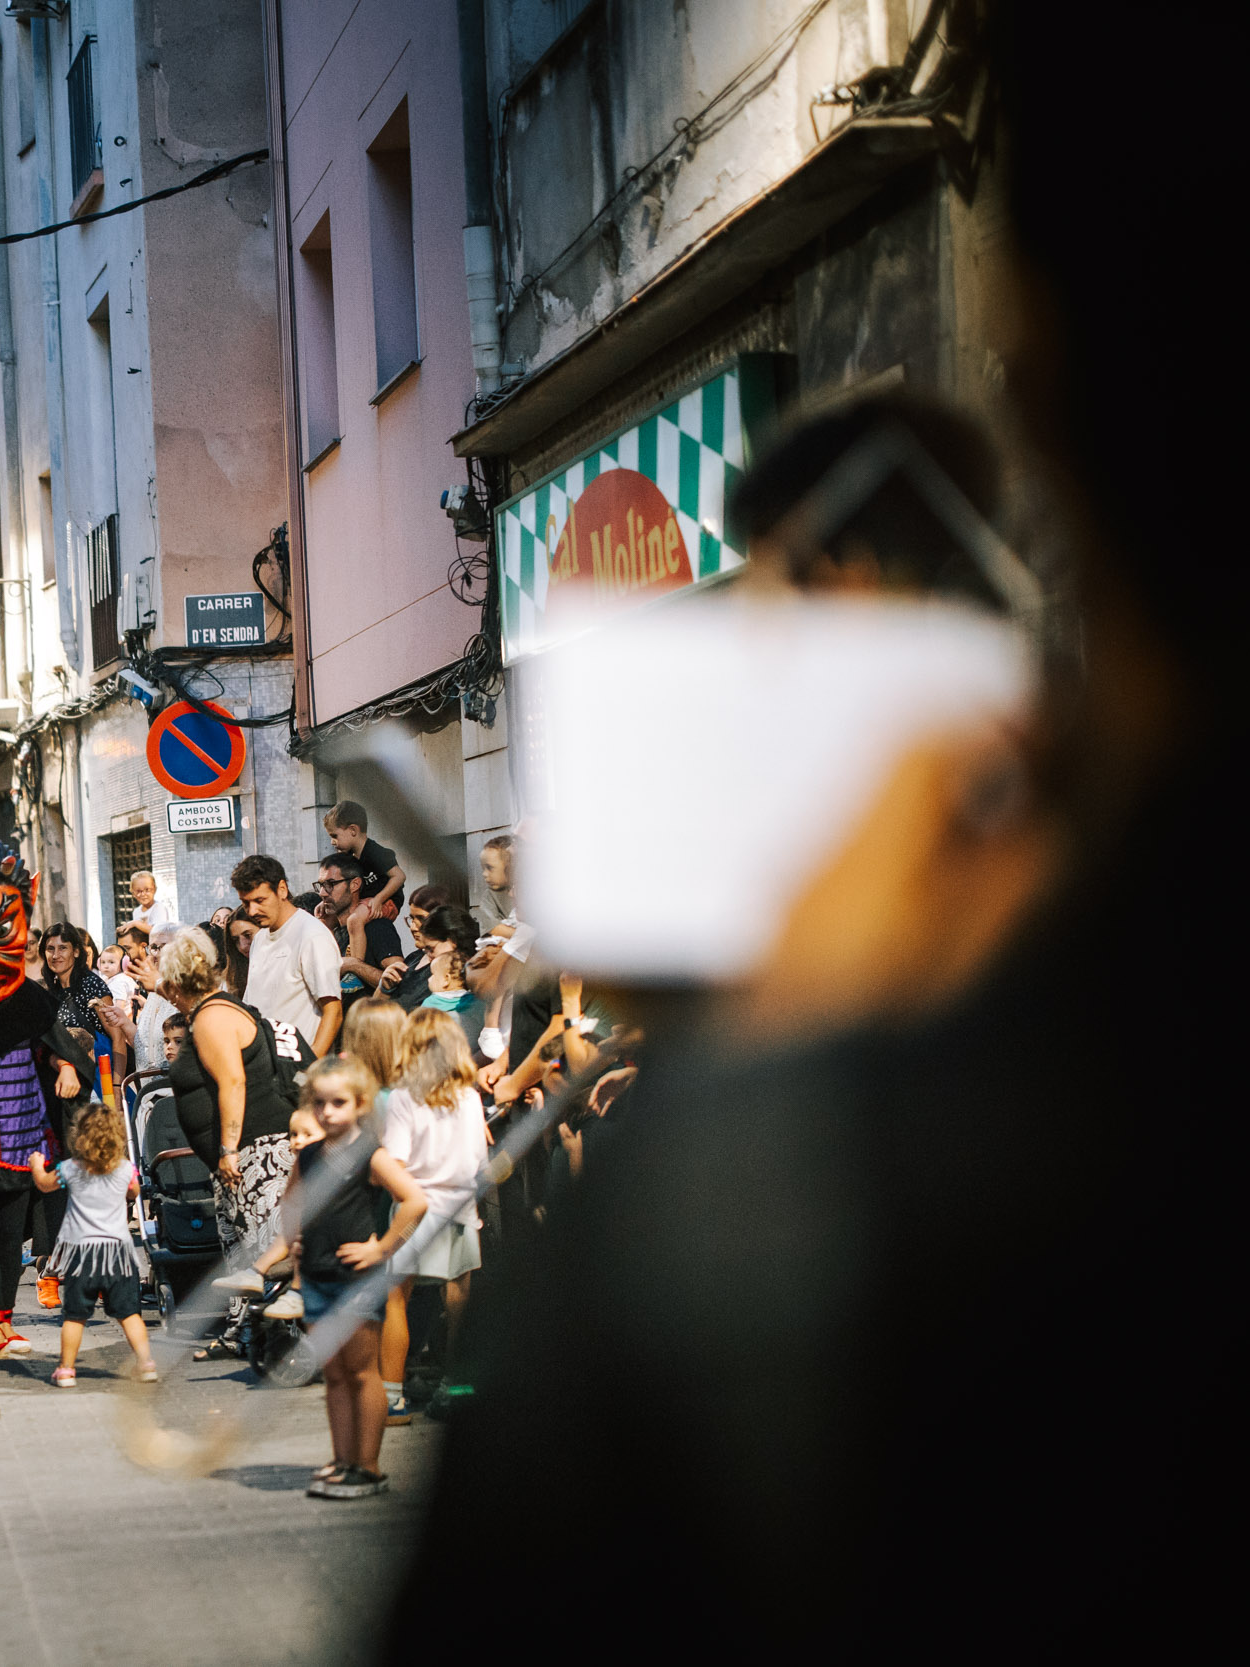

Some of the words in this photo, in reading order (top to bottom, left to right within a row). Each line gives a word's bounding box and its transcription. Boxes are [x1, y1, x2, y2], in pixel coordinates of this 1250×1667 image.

[546, 498, 579, 585] Cal
[591, 507, 680, 600] Moliné
[198, 597, 253, 611] CARRER
[192, 628, 217, 644] D'EN
[220, 626, 260, 642] SENDRA
[178, 816, 223, 827] COSTATS
[267, 1018, 302, 1062] JUS
